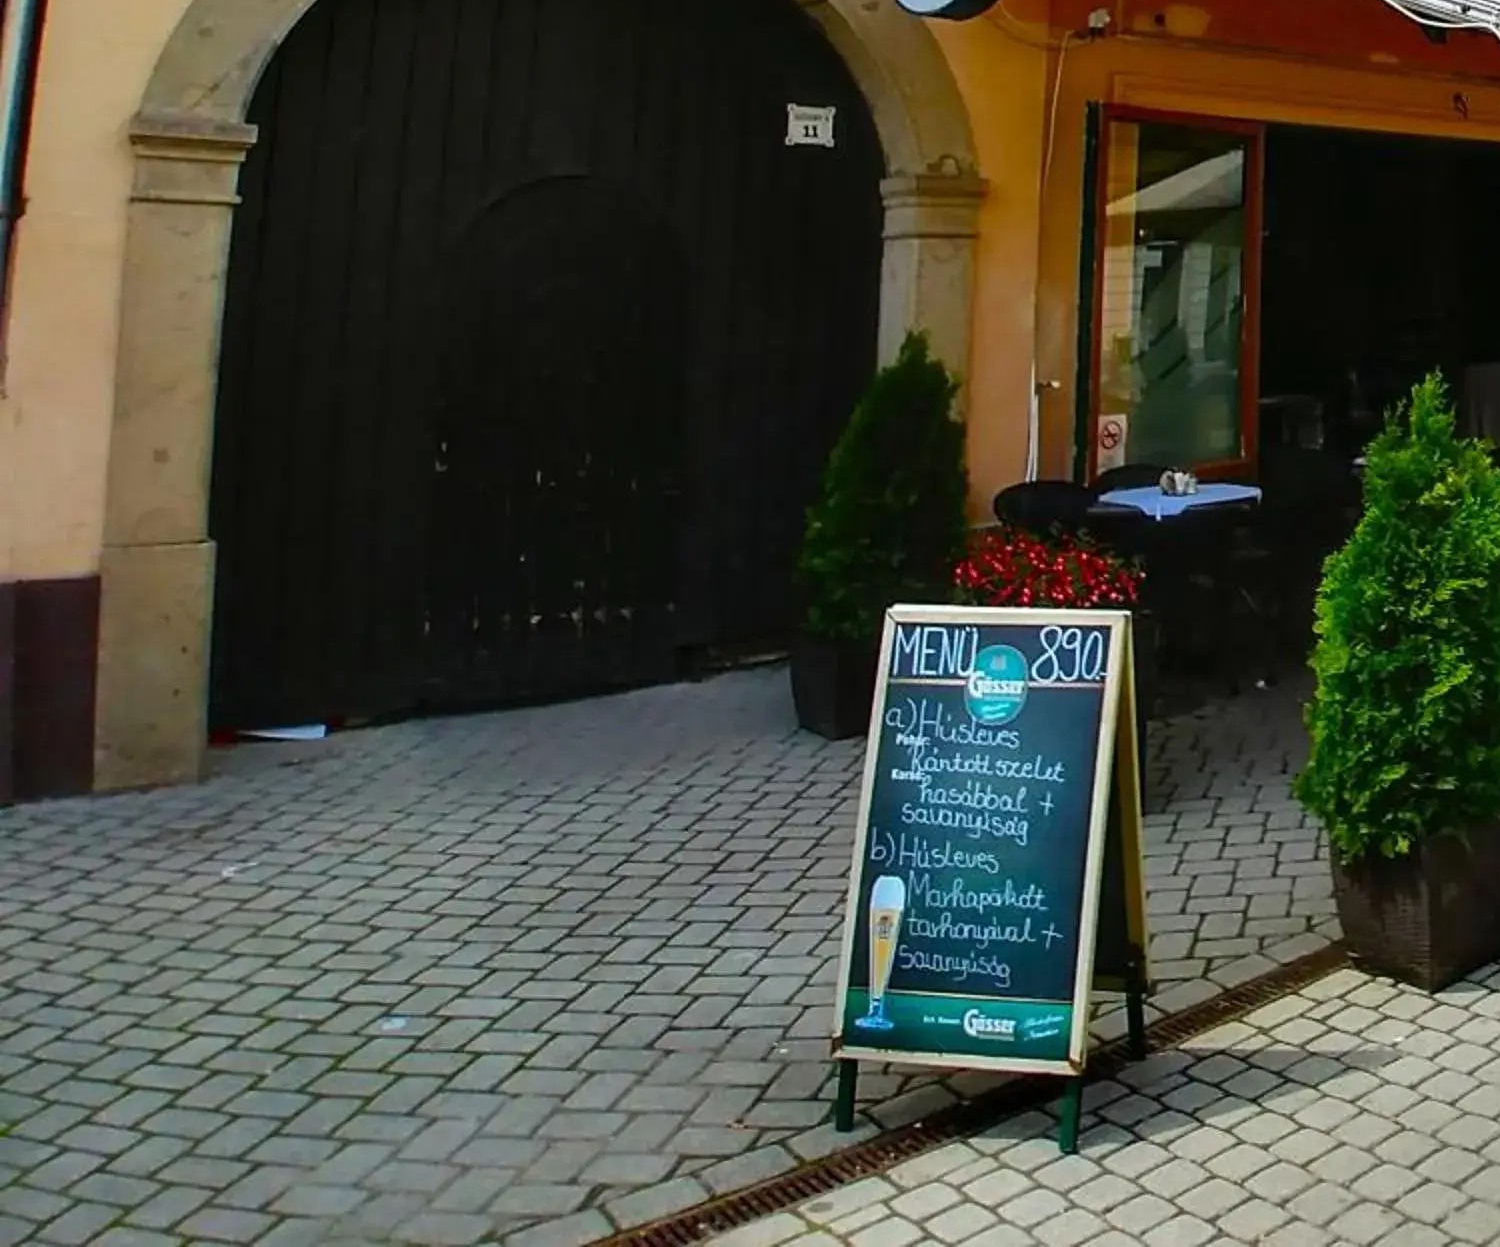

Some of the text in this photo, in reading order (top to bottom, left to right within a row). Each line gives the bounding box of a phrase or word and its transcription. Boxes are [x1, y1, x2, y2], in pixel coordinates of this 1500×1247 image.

[803, 125, 818, 138] 11
[893, 625, 977, 676] MENÜ
[898, 832, 1000, 874] Húsleves
[963, 1008, 1016, 1037] Gösser
